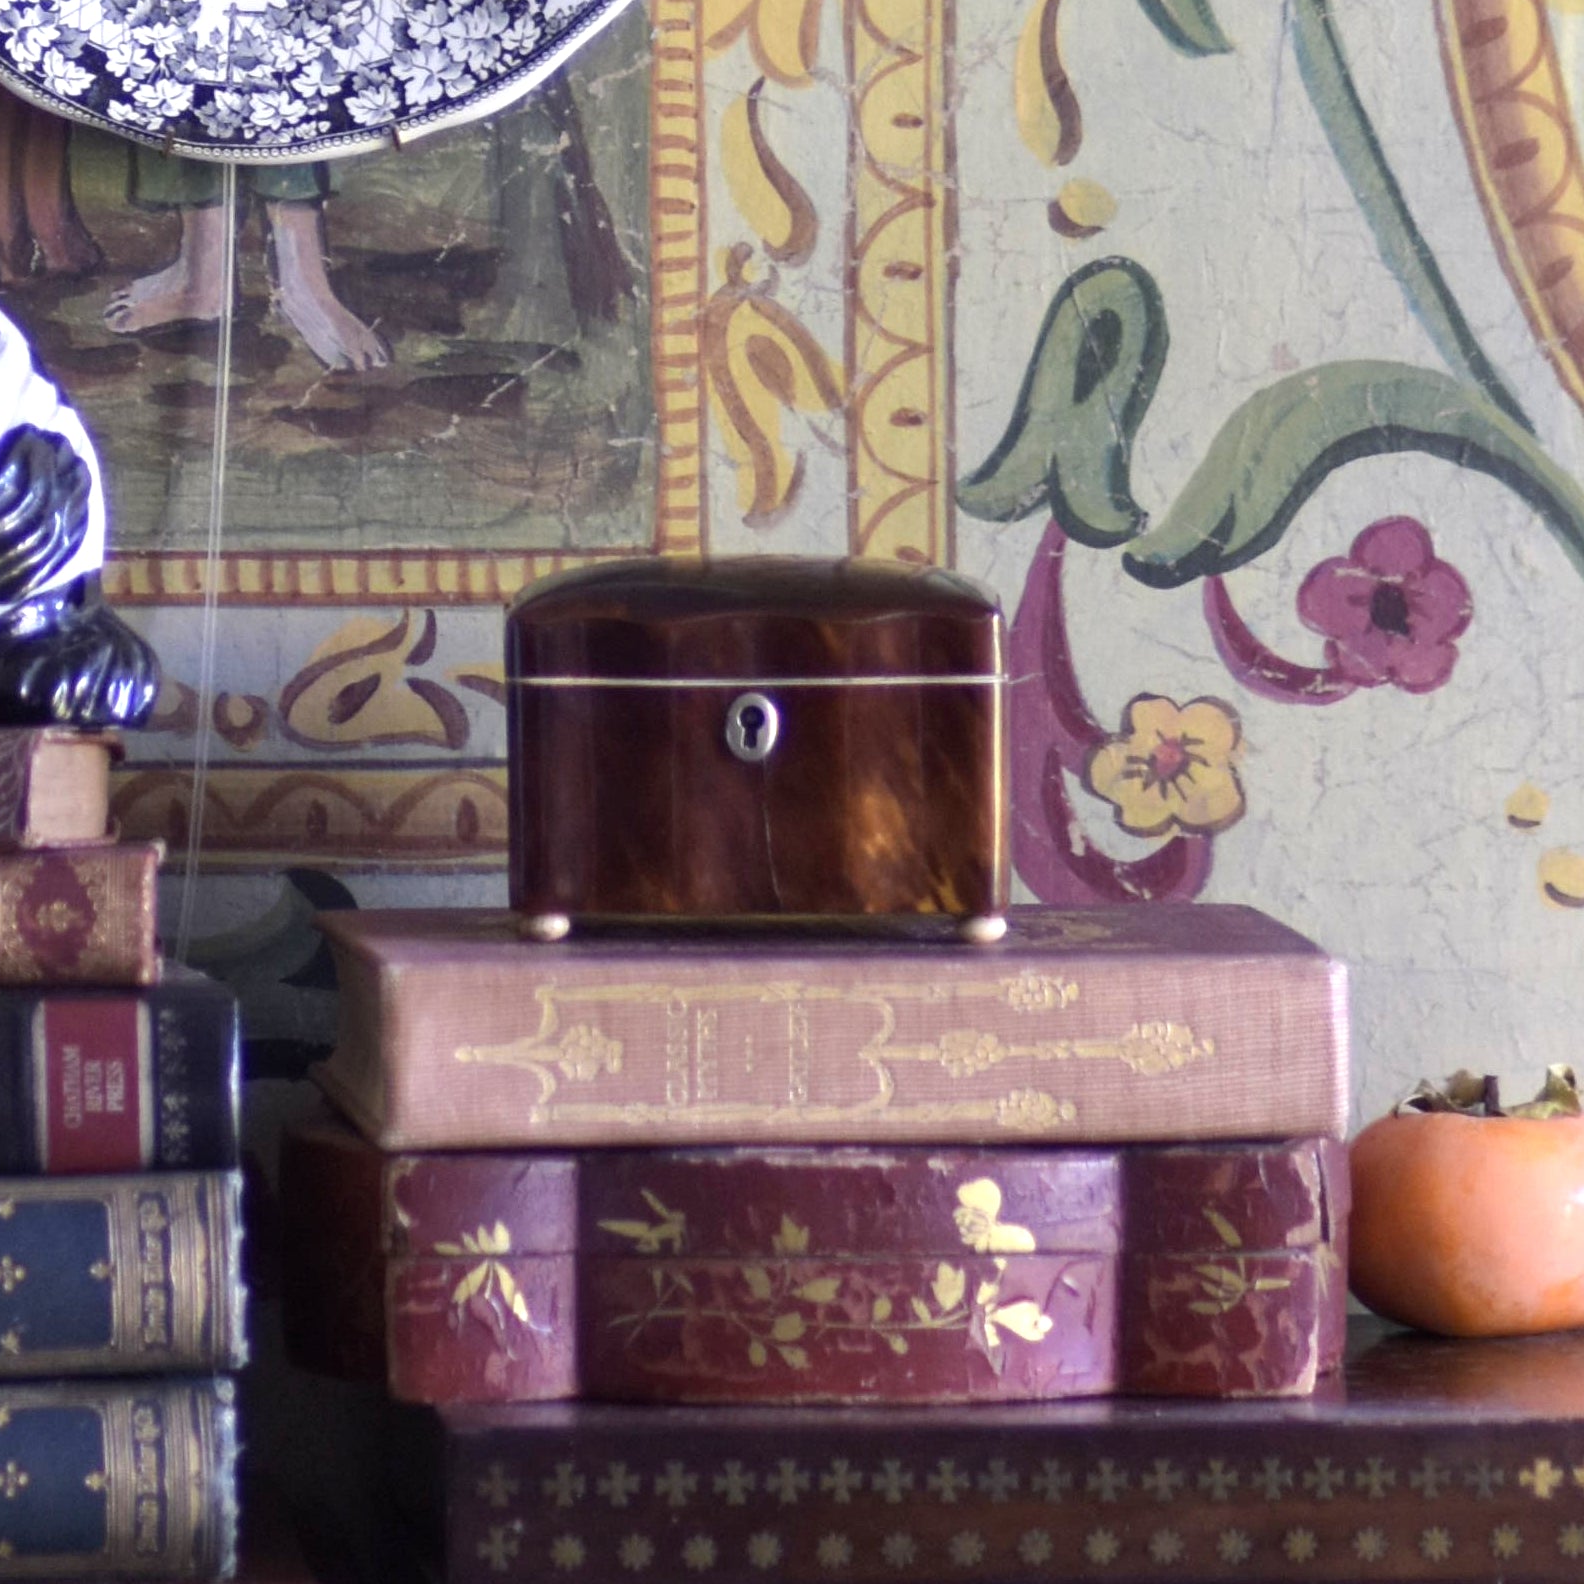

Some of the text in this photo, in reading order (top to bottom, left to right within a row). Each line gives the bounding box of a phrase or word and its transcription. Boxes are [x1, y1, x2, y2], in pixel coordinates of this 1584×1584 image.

[61, 1043, 82, 1129] CHATHAM
[83, 1058, 104, 1113] RIVER
[104, 1057, 126, 1113] PRESS
